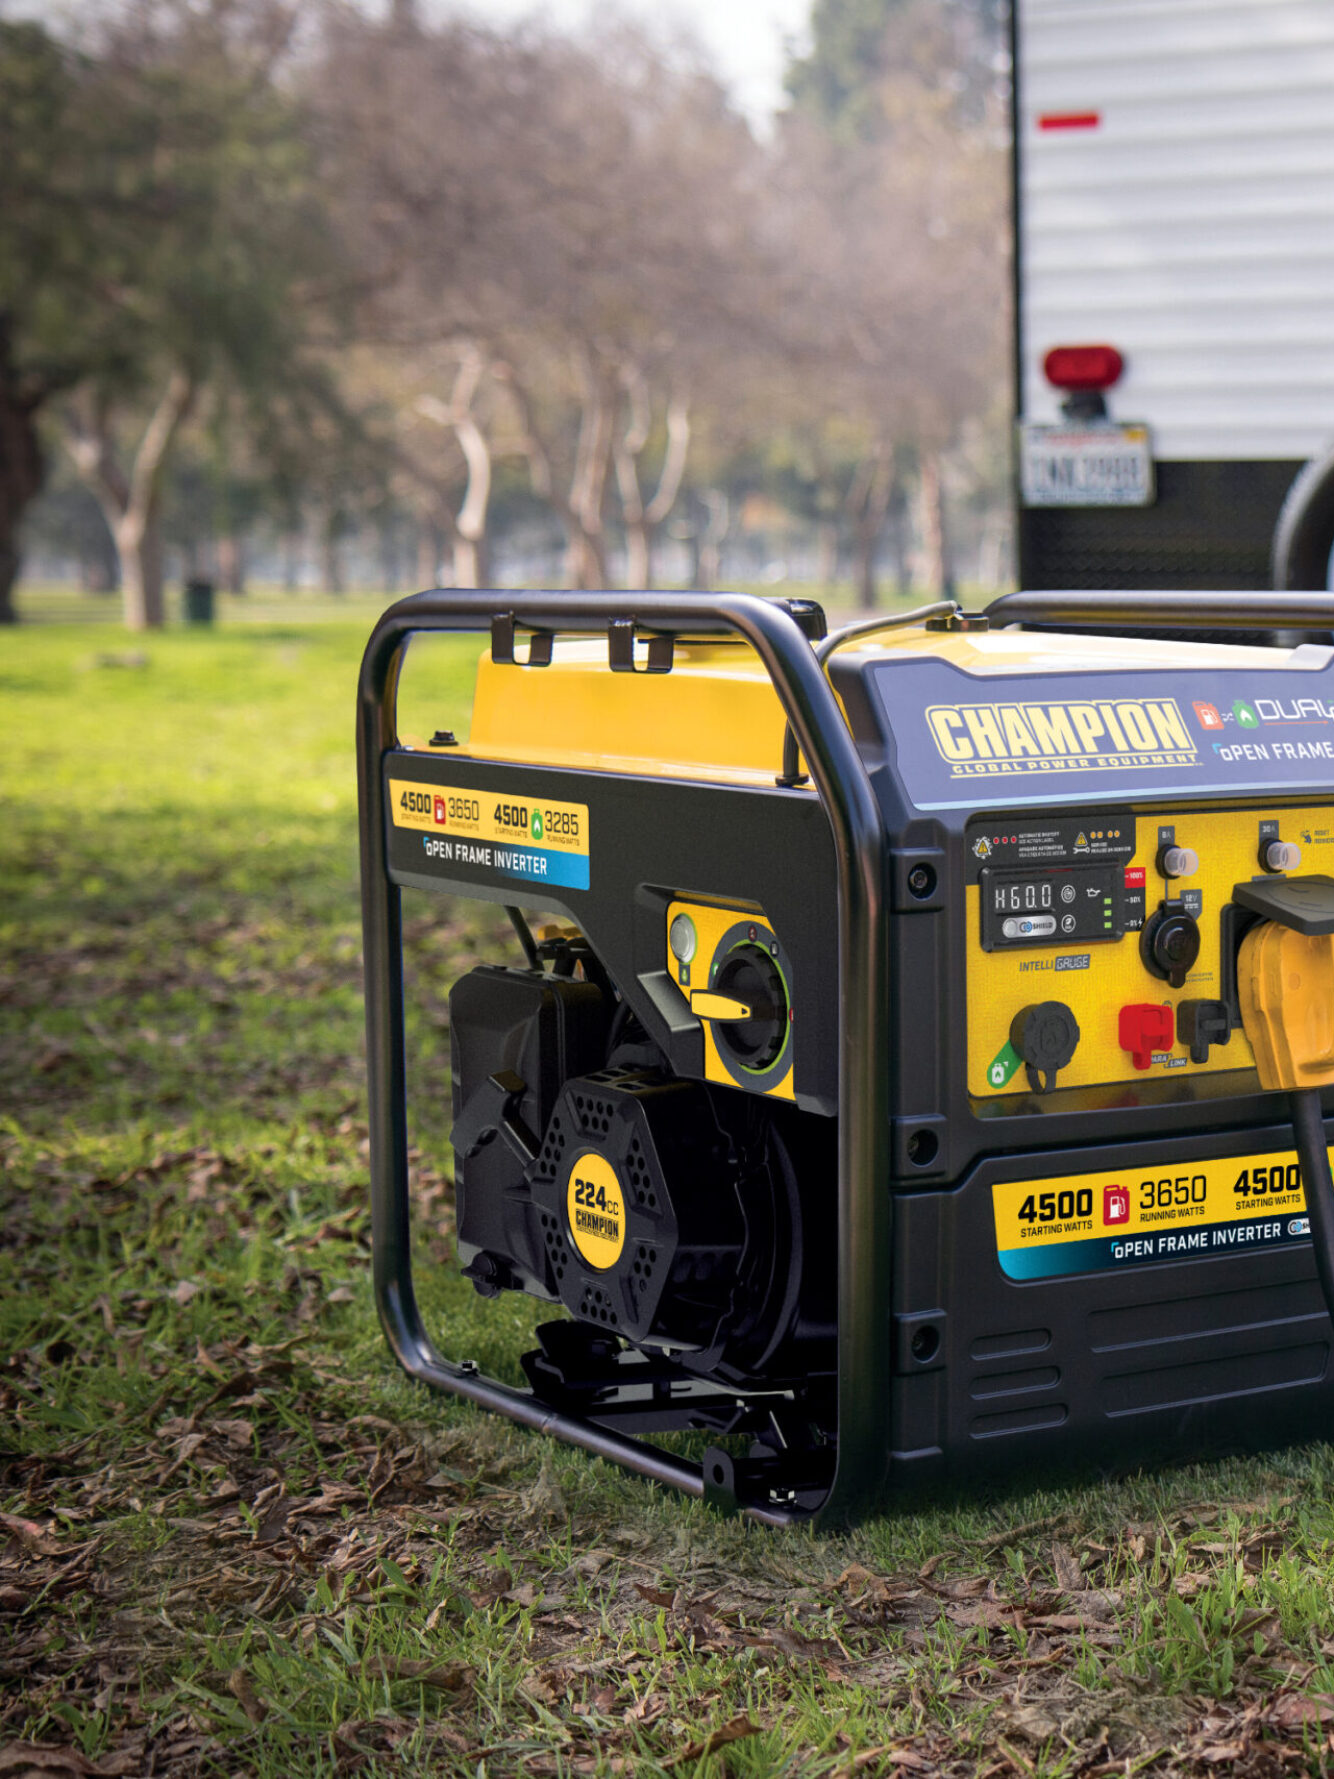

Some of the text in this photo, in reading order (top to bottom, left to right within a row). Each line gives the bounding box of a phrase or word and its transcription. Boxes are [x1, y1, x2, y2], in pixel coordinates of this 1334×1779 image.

[1254, 699, 1331, 720] DUAL
[928, 701, 1193, 760] CHAMPION
[953, 754, 1198, 775] GLOBAL POWER EQUIPMENT
[400, 791, 432, 814] 4500
[448, 797, 480, 821] 3650
[494, 803, 528, 828] 4500
[545, 810, 579, 836] 3285
[455, 845, 492, 866] FRAME
[494, 850, 548, 876] INVERTER
[1139, 1174, 1207, 1209] 3650
[1233, 1164, 1300, 1197] 4500
[1018, 1188, 1093, 1223] 4500
[1139, 1206, 1205, 1223] RUNNING WATTS
[1235, 1193, 1301, 1211] STARTING WATTS
[575, 1209, 619, 1238] CHAMPION
[1020, 1220, 1093, 1238] STARTING WATTS
[1158, 1232, 1208, 1253] FRAME
[1212, 1221, 1281, 1246] INVERTER
